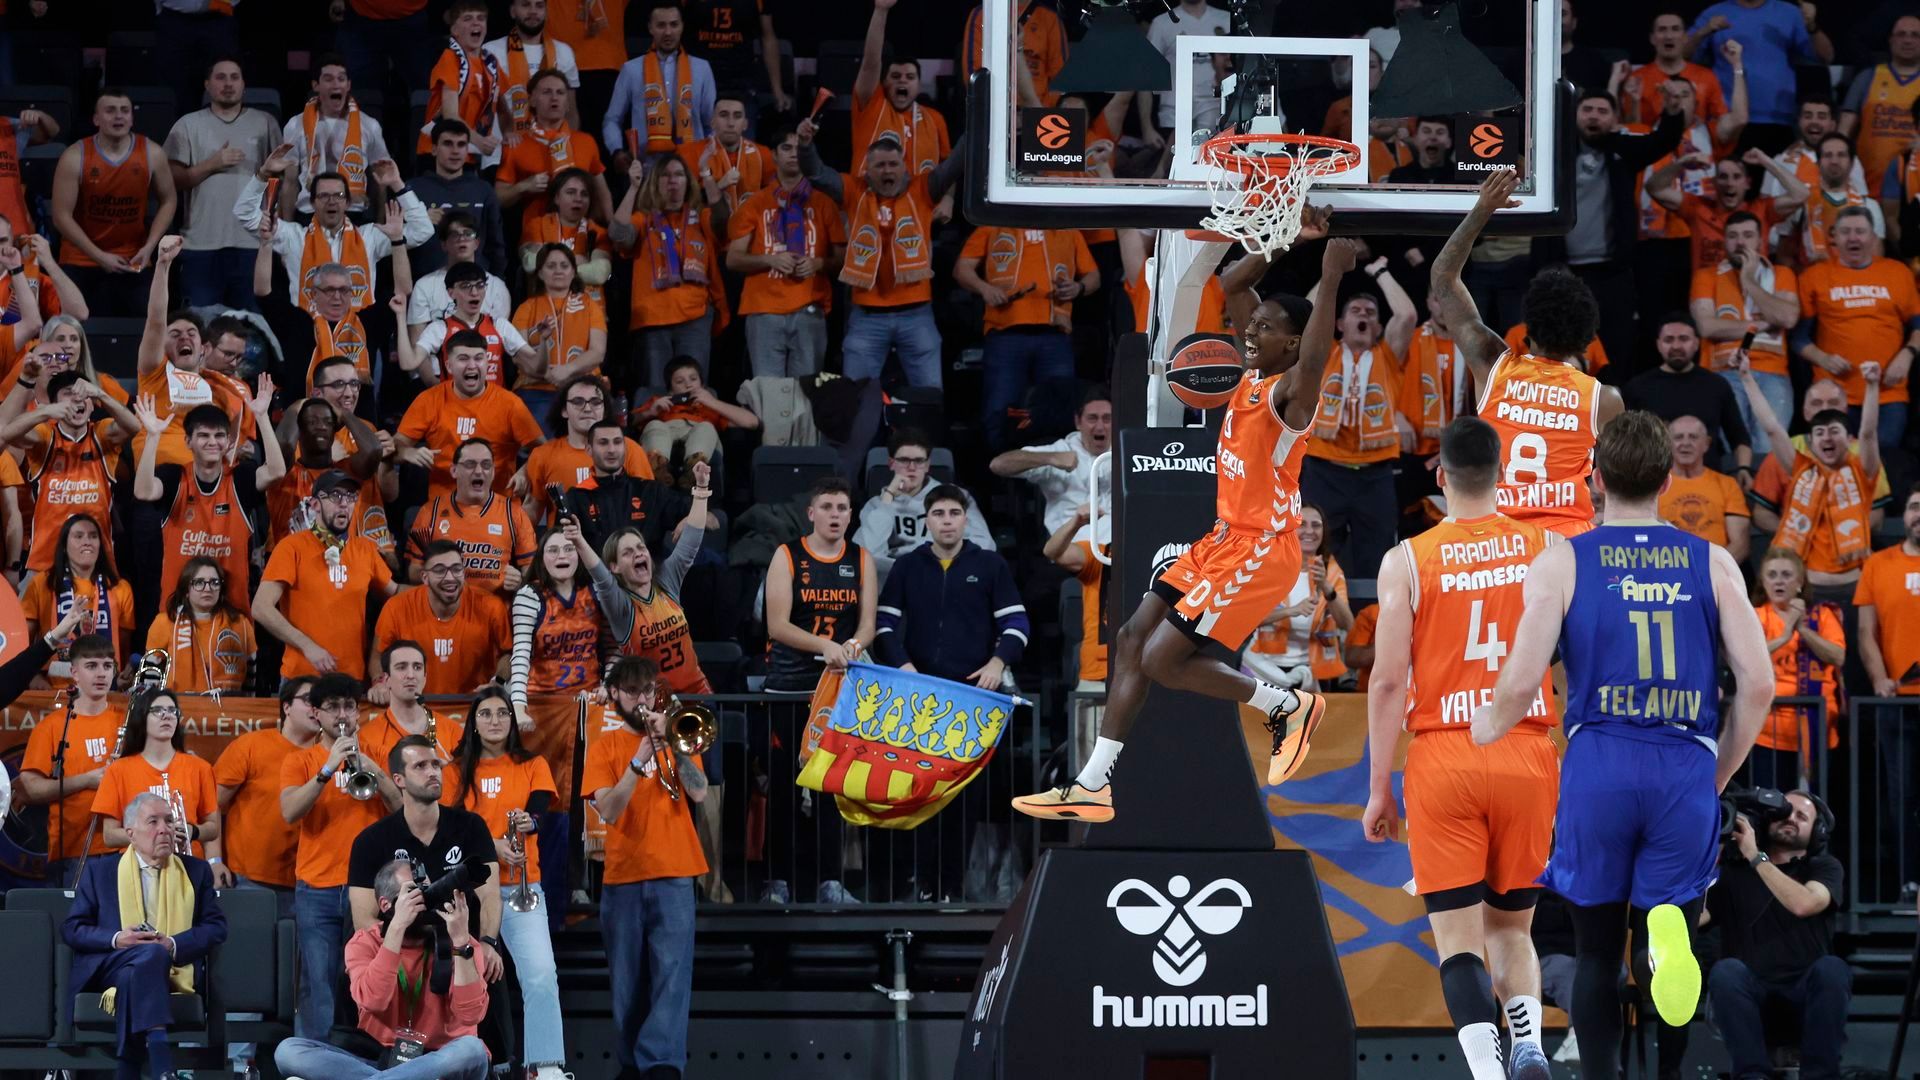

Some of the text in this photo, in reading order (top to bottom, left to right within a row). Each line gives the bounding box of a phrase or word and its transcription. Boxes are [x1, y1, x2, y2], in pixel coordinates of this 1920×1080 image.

[712, 7, 734, 29] 13
[1024, 152, 1083, 165] EuroLeague
[1457, 161, 1516, 172] EuroLeague
[1829, 284, 1891, 301] VALENCIA
[1503, 379, 1580, 410] MONTERO
[456, 416, 477, 435] VBC
[1496, 402, 1579, 432] PAMESA
[1132, 455, 1218, 475] SPALDING
[1505, 432, 1548, 486] 8
[48, 478, 89, 492] Cultura
[576, 467, 590, 484] VB
[47, 491, 99, 505] Esfuerzo
[1495, 482, 1576, 508] ALENCIA
[182, 529, 223, 545] Cultura
[456, 539, 492, 554] ltura
[1440, 534, 1526, 567] PRADILLA
[1599, 545, 1690, 569] RAYMAN
[329, 565, 348, 583] VBC
[461, 556, 501, 570] uerzo
[1440, 563, 1529, 593] PAMESA
[800, 589, 858, 604] VALENCIA
[1186, 579, 1212, 607] 0
[1621, 579, 1682, 605] Amy
[639, 614, 678, 637] Cultura
[811, 615, 838, 641] 13
[1463, 599, 1507, 673] 4
[434, 638, 454, 657] VBC
[659, 641, 685, 673] 23
[1628, 610, 1677, 681] 11
[555, 665, 586, 689] 23
[1440, 686, 1547, 724] VALEA
[1598, 684, 1702, 722] TEL AVIV
[85, 737, 107, 758] VBC
[481, 777, 501, 793] VBC
[1092, 984, 1268, 1028] hummel
